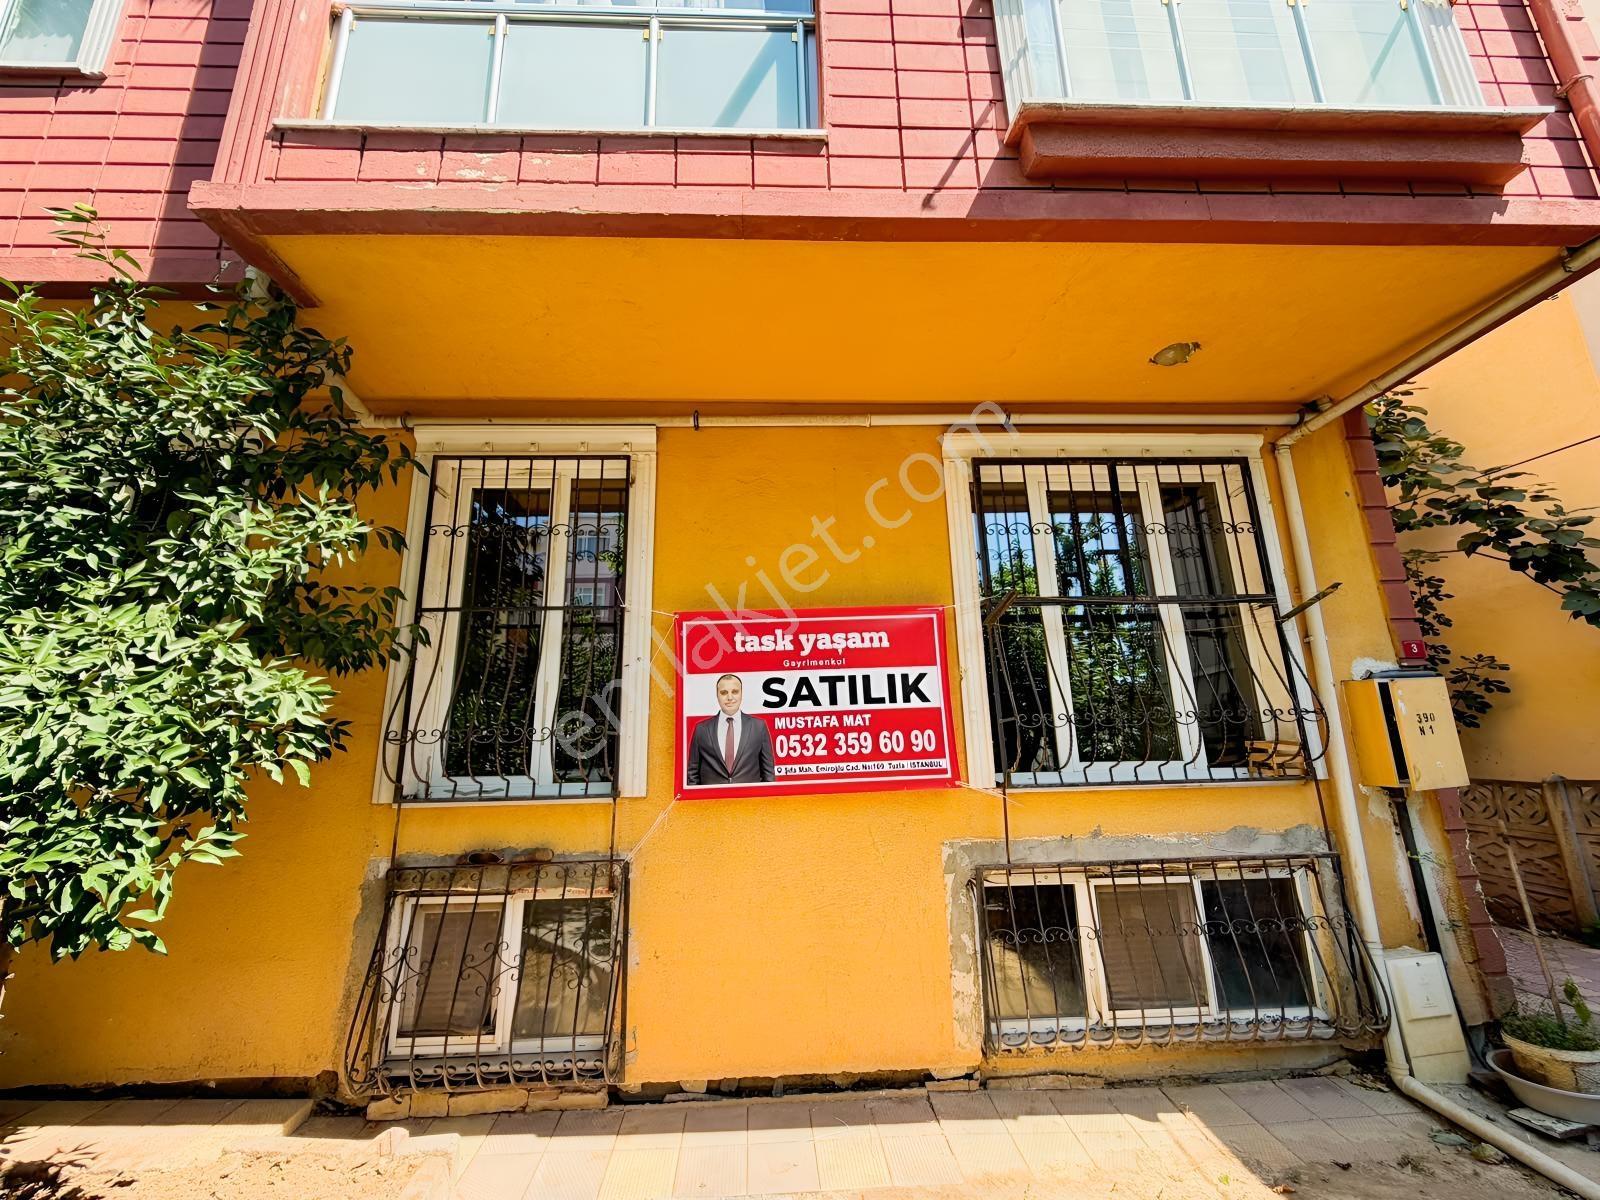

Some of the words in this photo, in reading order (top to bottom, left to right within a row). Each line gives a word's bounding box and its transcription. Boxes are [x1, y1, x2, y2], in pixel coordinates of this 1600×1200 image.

[734, 629, 794, 653] task
[798, 631, 890, 656] yaşam
[1411, 643, 1418, 653] 3
[762, 672, 931, 709] SATILIK
[775, 716, 839, 730] MUSTAFA
[843, 714, 871, 727] MAT
[1416, 712, 1436, 724] 390
[775, 732, 828, 758] 0532
[834, 731, 872, 755] 359
[879, 730, 905, 753] 60
[911, 729, 936, 752] 90
